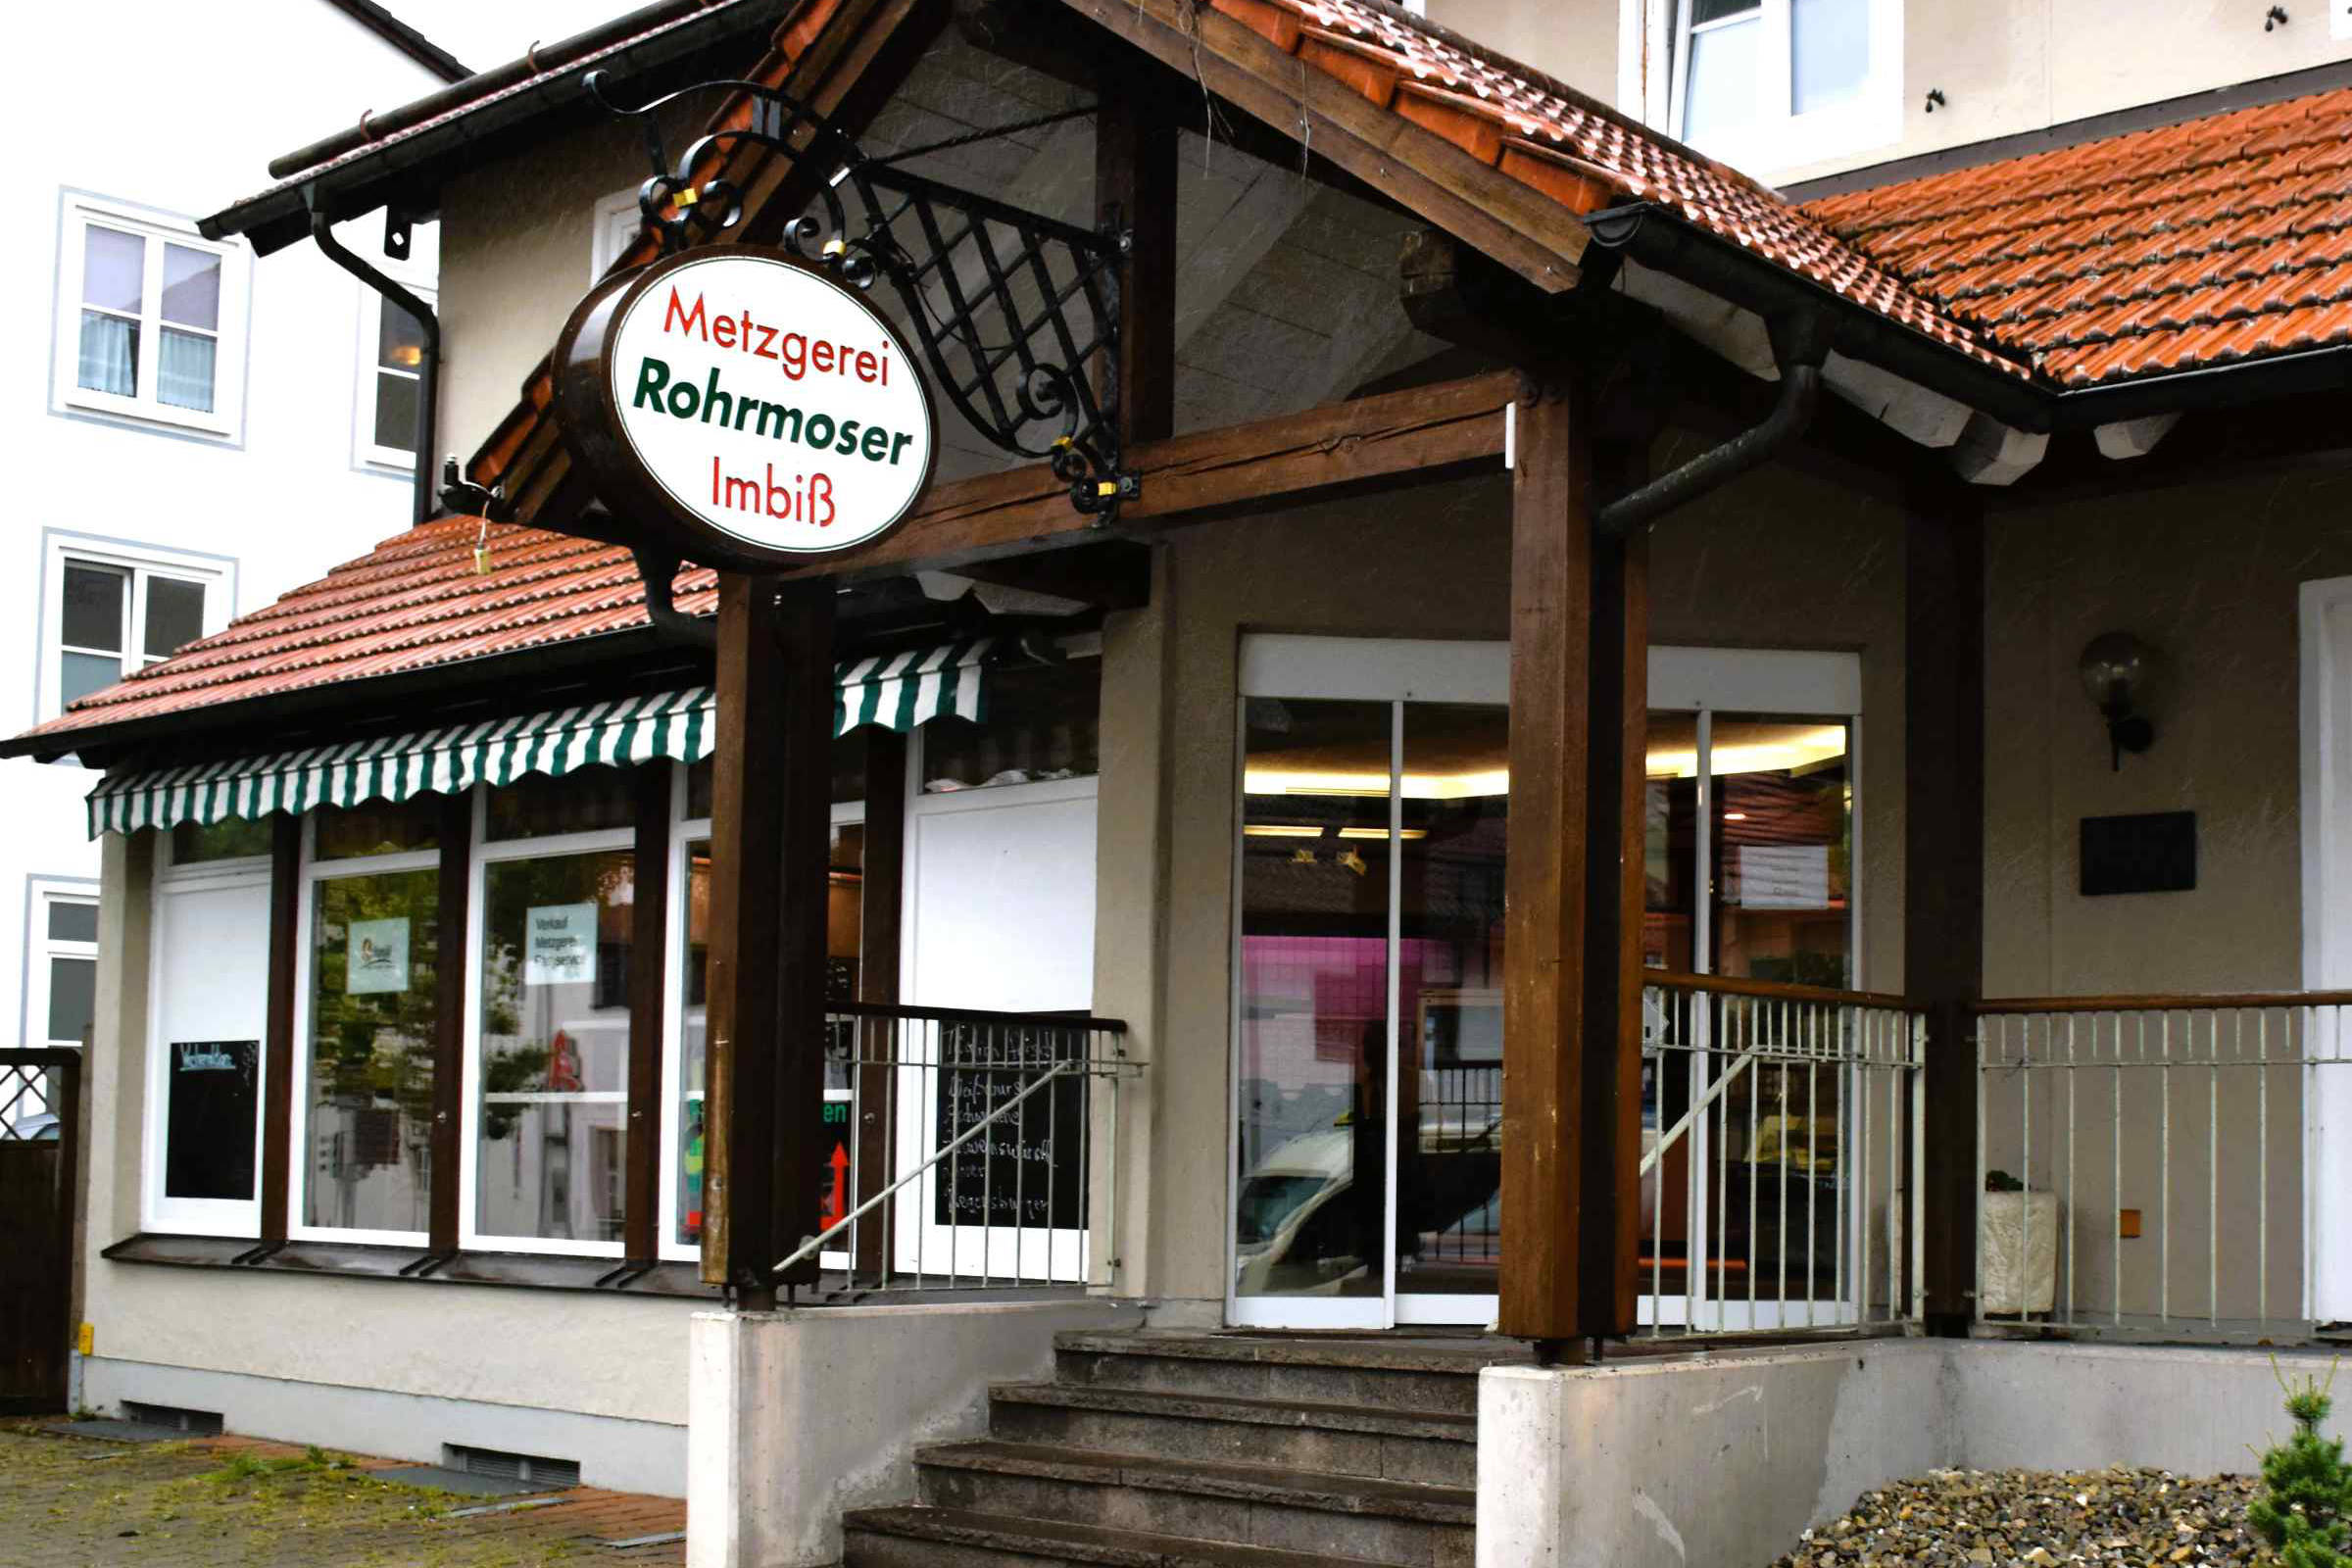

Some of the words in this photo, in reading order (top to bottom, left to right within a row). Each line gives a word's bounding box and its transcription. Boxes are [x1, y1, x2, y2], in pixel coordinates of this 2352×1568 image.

[663, 284, 889, 386] Metzgerei
[632, 356, 913, 466] Rohrmoser
[711, 456, 836, 528] Imbiß
